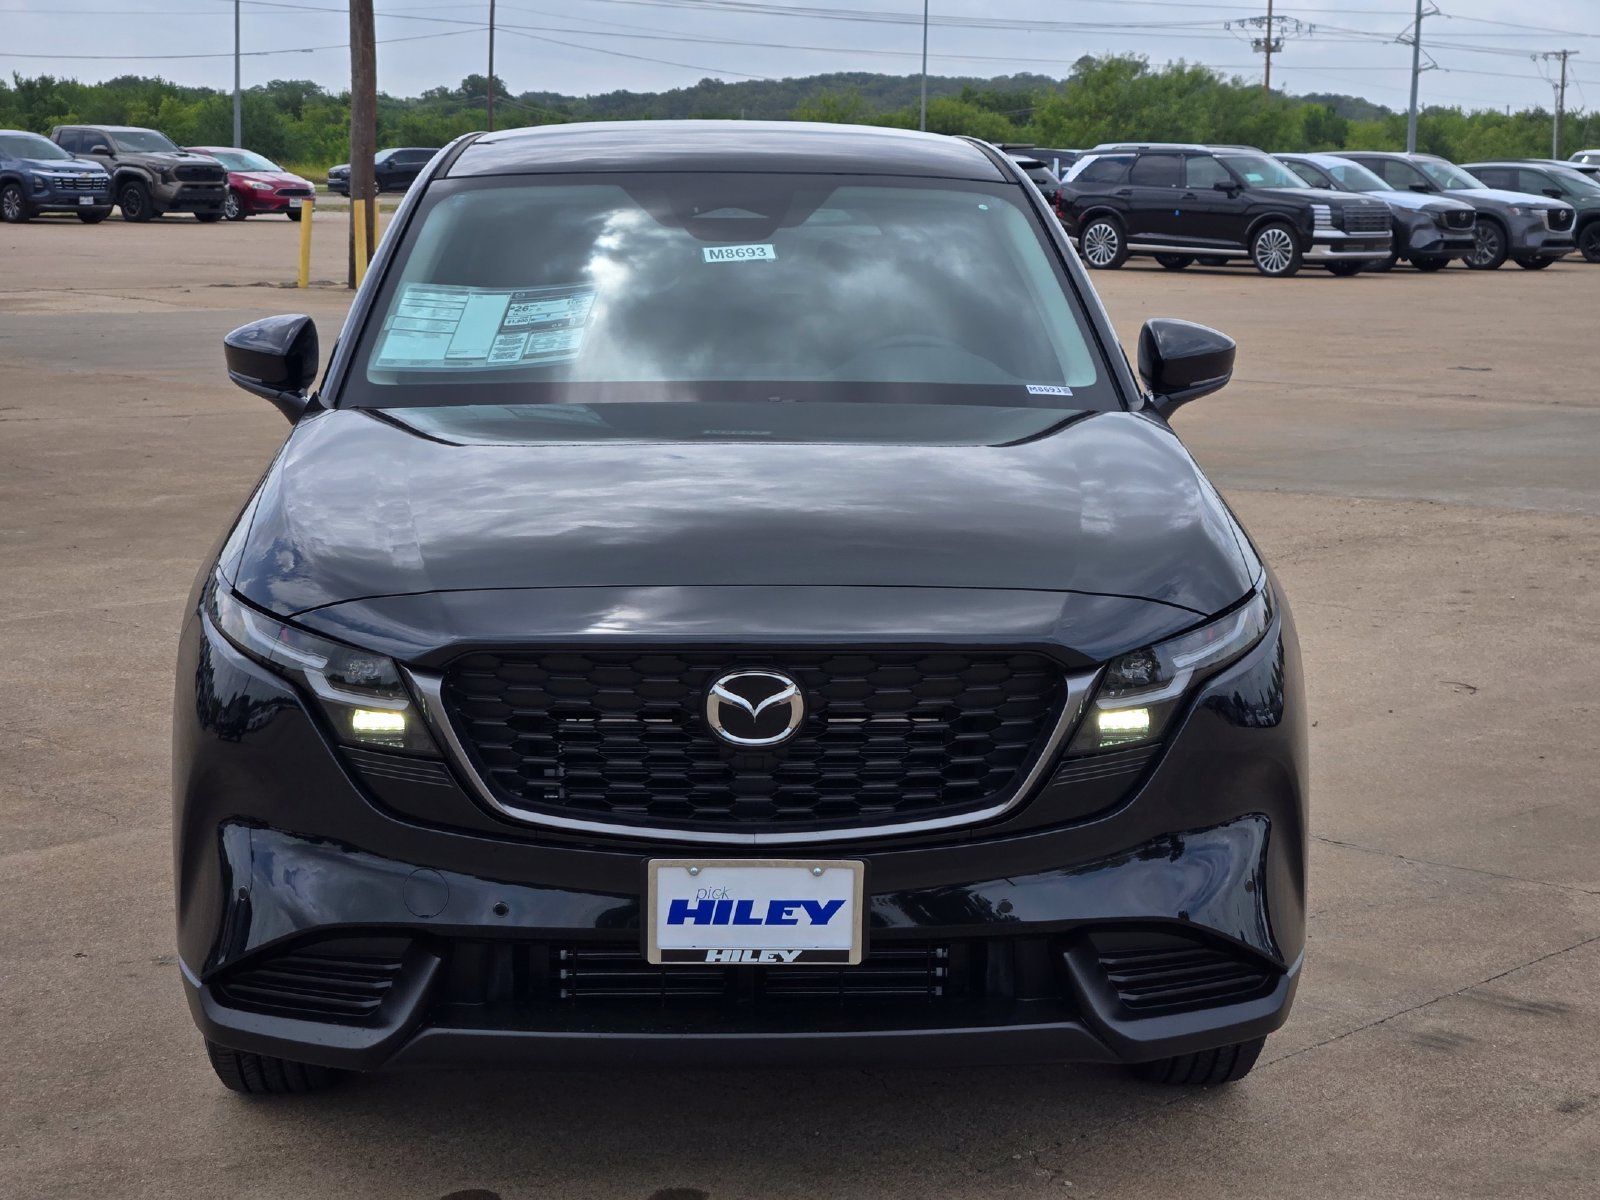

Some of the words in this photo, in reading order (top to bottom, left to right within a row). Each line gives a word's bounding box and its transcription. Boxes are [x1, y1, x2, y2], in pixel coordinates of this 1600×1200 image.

[708, 247, 767, 260] M8693
[695, 886, 731, 901] pick
[667, 899, 847, 926] HILEY
[704, 949, 803, 964] HILEY
